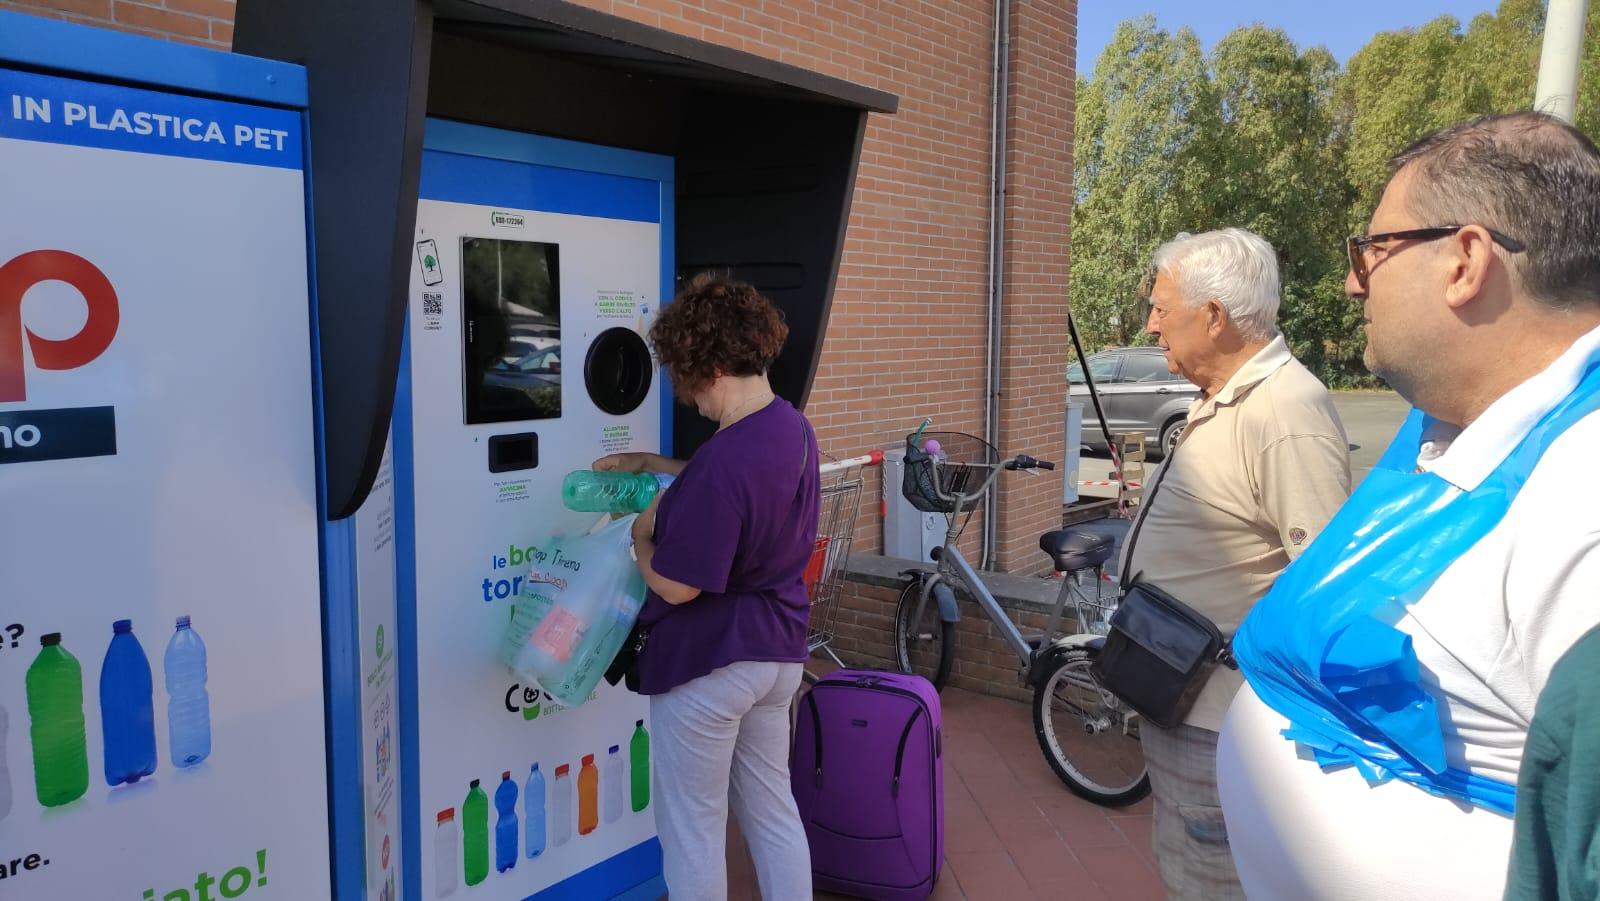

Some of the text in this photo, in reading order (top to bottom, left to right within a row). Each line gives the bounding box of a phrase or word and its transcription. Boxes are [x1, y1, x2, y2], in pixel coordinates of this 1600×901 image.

[12, 95, 289, 151] IN PLASTICA PET
[493, 555, 507, 570] le
[482, 575, 525, 602] tor
